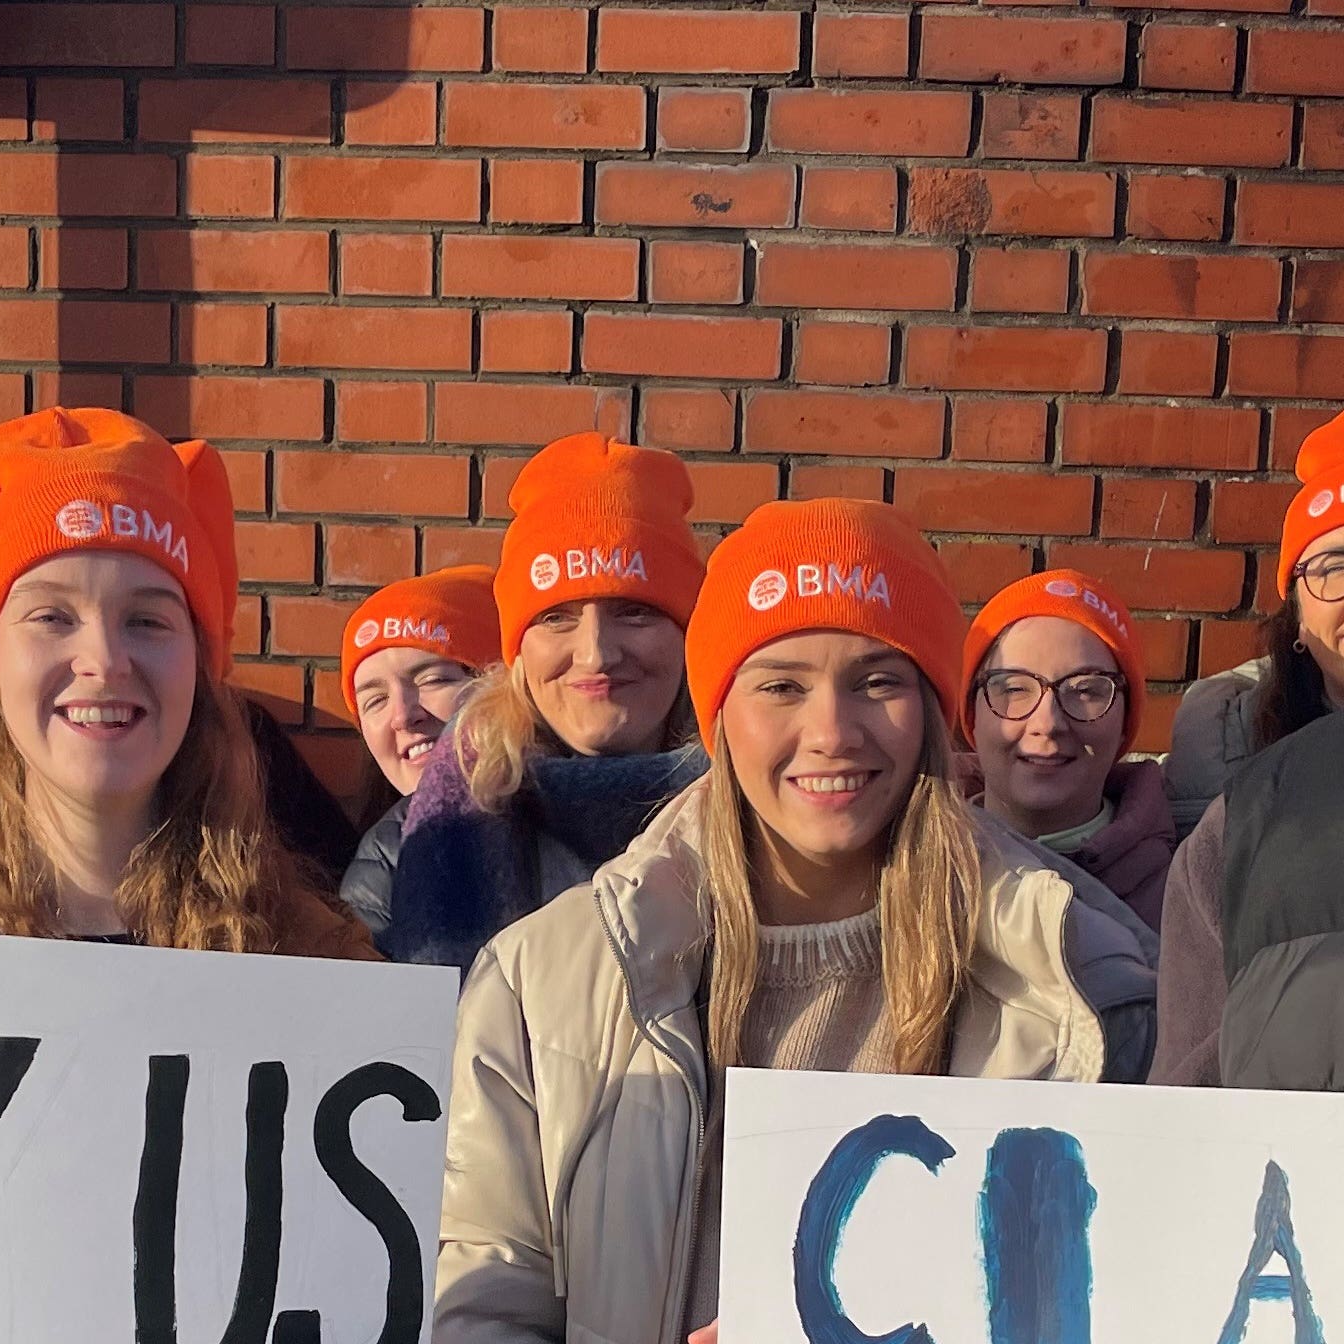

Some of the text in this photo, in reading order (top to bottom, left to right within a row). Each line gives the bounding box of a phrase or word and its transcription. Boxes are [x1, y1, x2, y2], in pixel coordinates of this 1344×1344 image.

[111, 502, 192, 574] BMA
[565, 546, 649, 582] BMA
[797, 563, 893, 610] BMA
[383, 617, 451, 644] BMA
[1083, 589, 1129, 639] BMA
